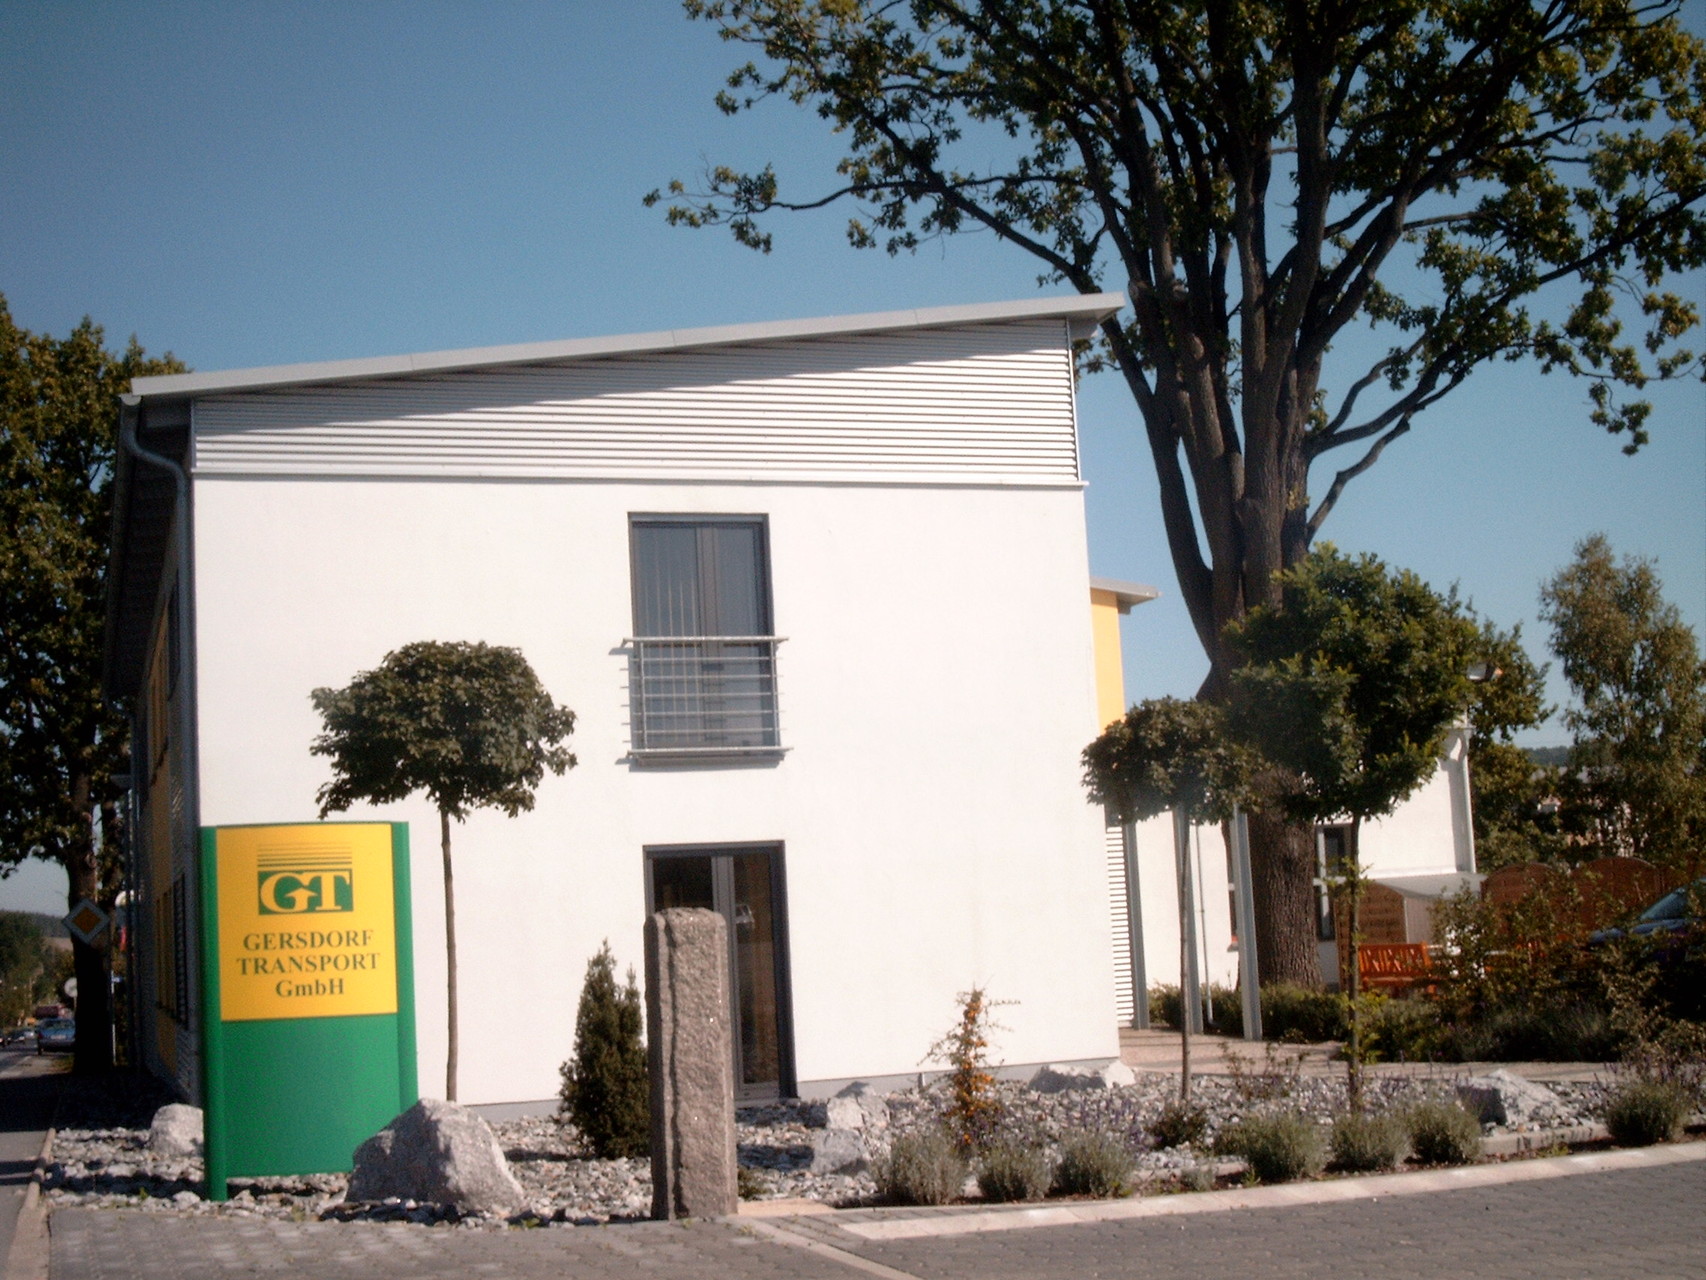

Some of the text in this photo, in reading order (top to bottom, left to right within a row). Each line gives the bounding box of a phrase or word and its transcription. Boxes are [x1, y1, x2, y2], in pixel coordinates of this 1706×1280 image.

[260, 871, 350, 913] GT
[243, 930, 373, 951] GERSDORF
[237, 953, 380, 975] TRANSPORT
[276, 979, 344, 998] GmbH
